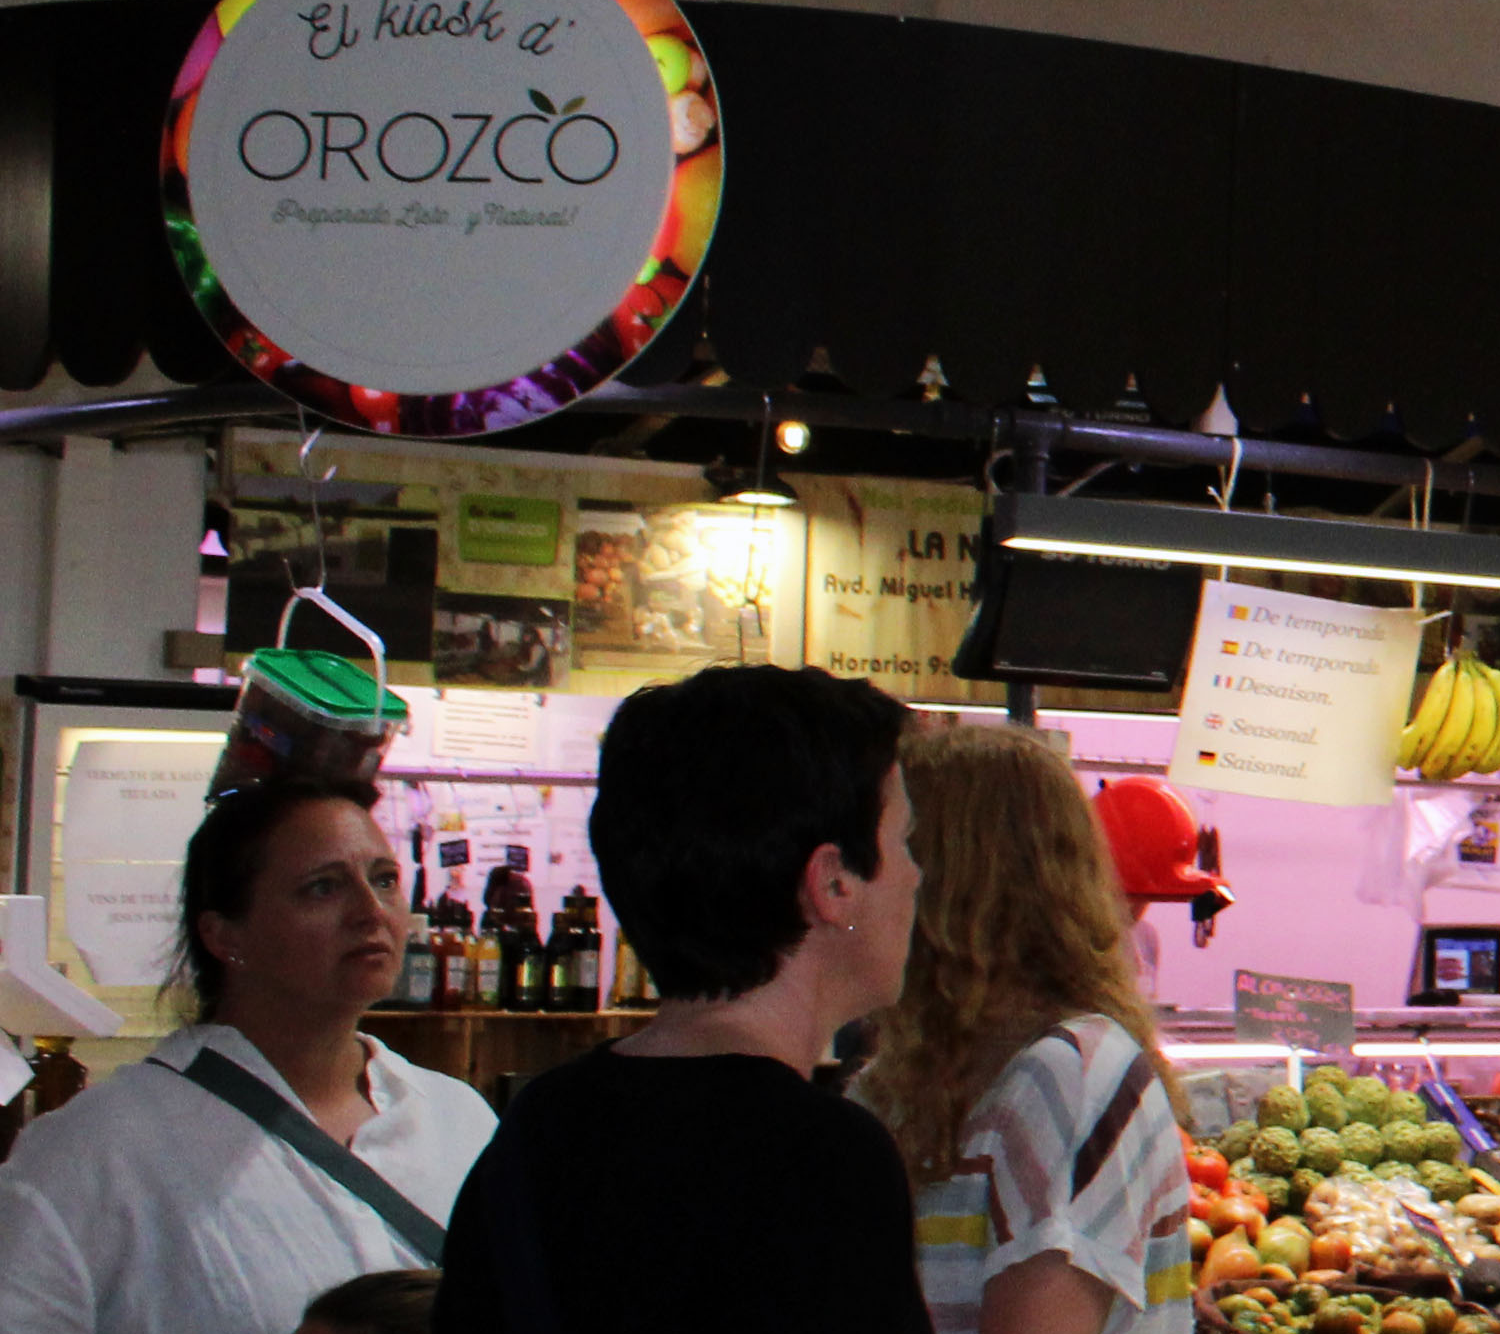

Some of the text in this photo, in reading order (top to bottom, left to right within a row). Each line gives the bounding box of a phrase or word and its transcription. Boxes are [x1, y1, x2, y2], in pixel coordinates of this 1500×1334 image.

[297, 2, 359, 60] El
[238, 108, 619, 185] OROZCO
[880, 576, 953, 603] Miguel
[1251, 605, 1282, 623] De
[1242, 640, 1273, 660] De
